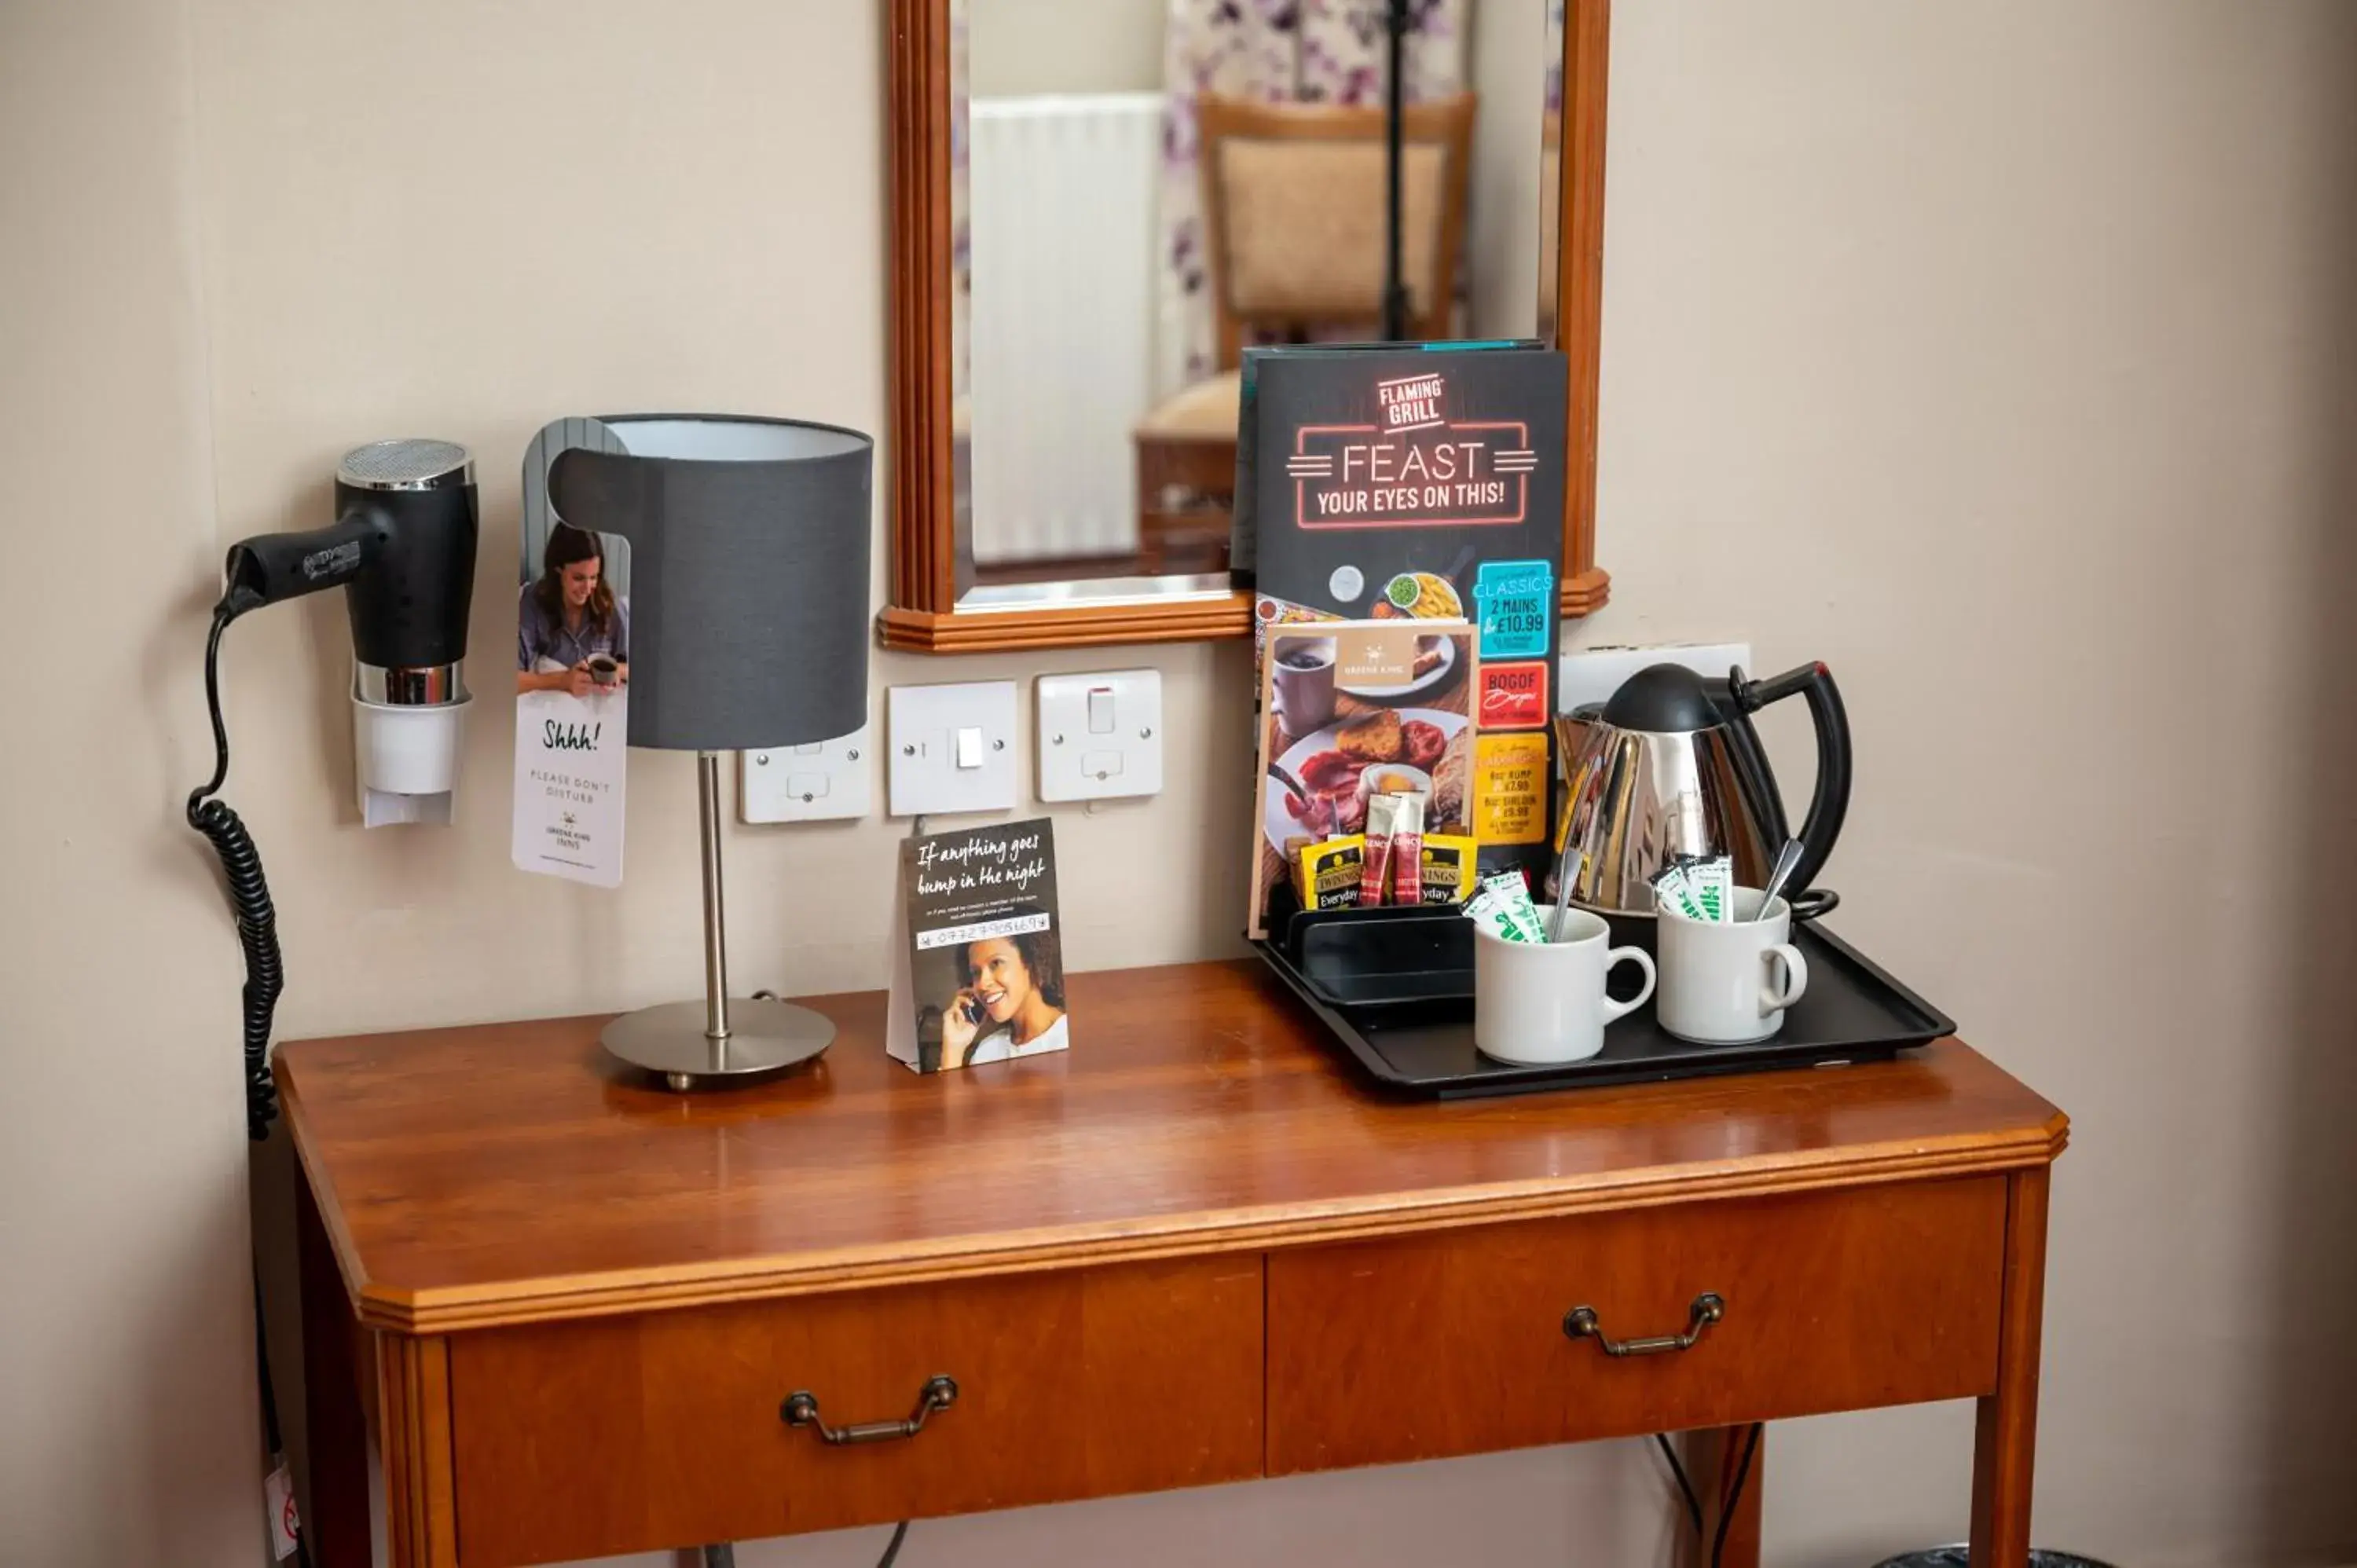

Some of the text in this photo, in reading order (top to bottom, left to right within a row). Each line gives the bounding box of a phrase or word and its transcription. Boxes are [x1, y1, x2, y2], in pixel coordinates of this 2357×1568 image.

[1379, 379, 1442, 406] FLAMING
[1388, 398, 1439, 425] GRILL
[1343, 442, 1485, 483] FEAST
[1318, 482, 1505, 515] YOUR EYES ON THIS!
[1472, 576, 1555, 598] CLASSICS
[1491, 598, 1538, 615] 2 MAINS
[1497, 614, 1544, 633] £10.99
[1488, 672, 1536, 690] BOGOF
[543, 718, 601, 750] Shhh!
[530, 769, 610, 793] PLEASE DON'T
[546, 787, 593, 804] DISTURB
[918, 834, 1039, 870] If anything goes
[917, 857, 1046, 896] bump in the night
[1321, 889, 1358, 907] Everyday
[1422, 888, 1450, 903] yday
